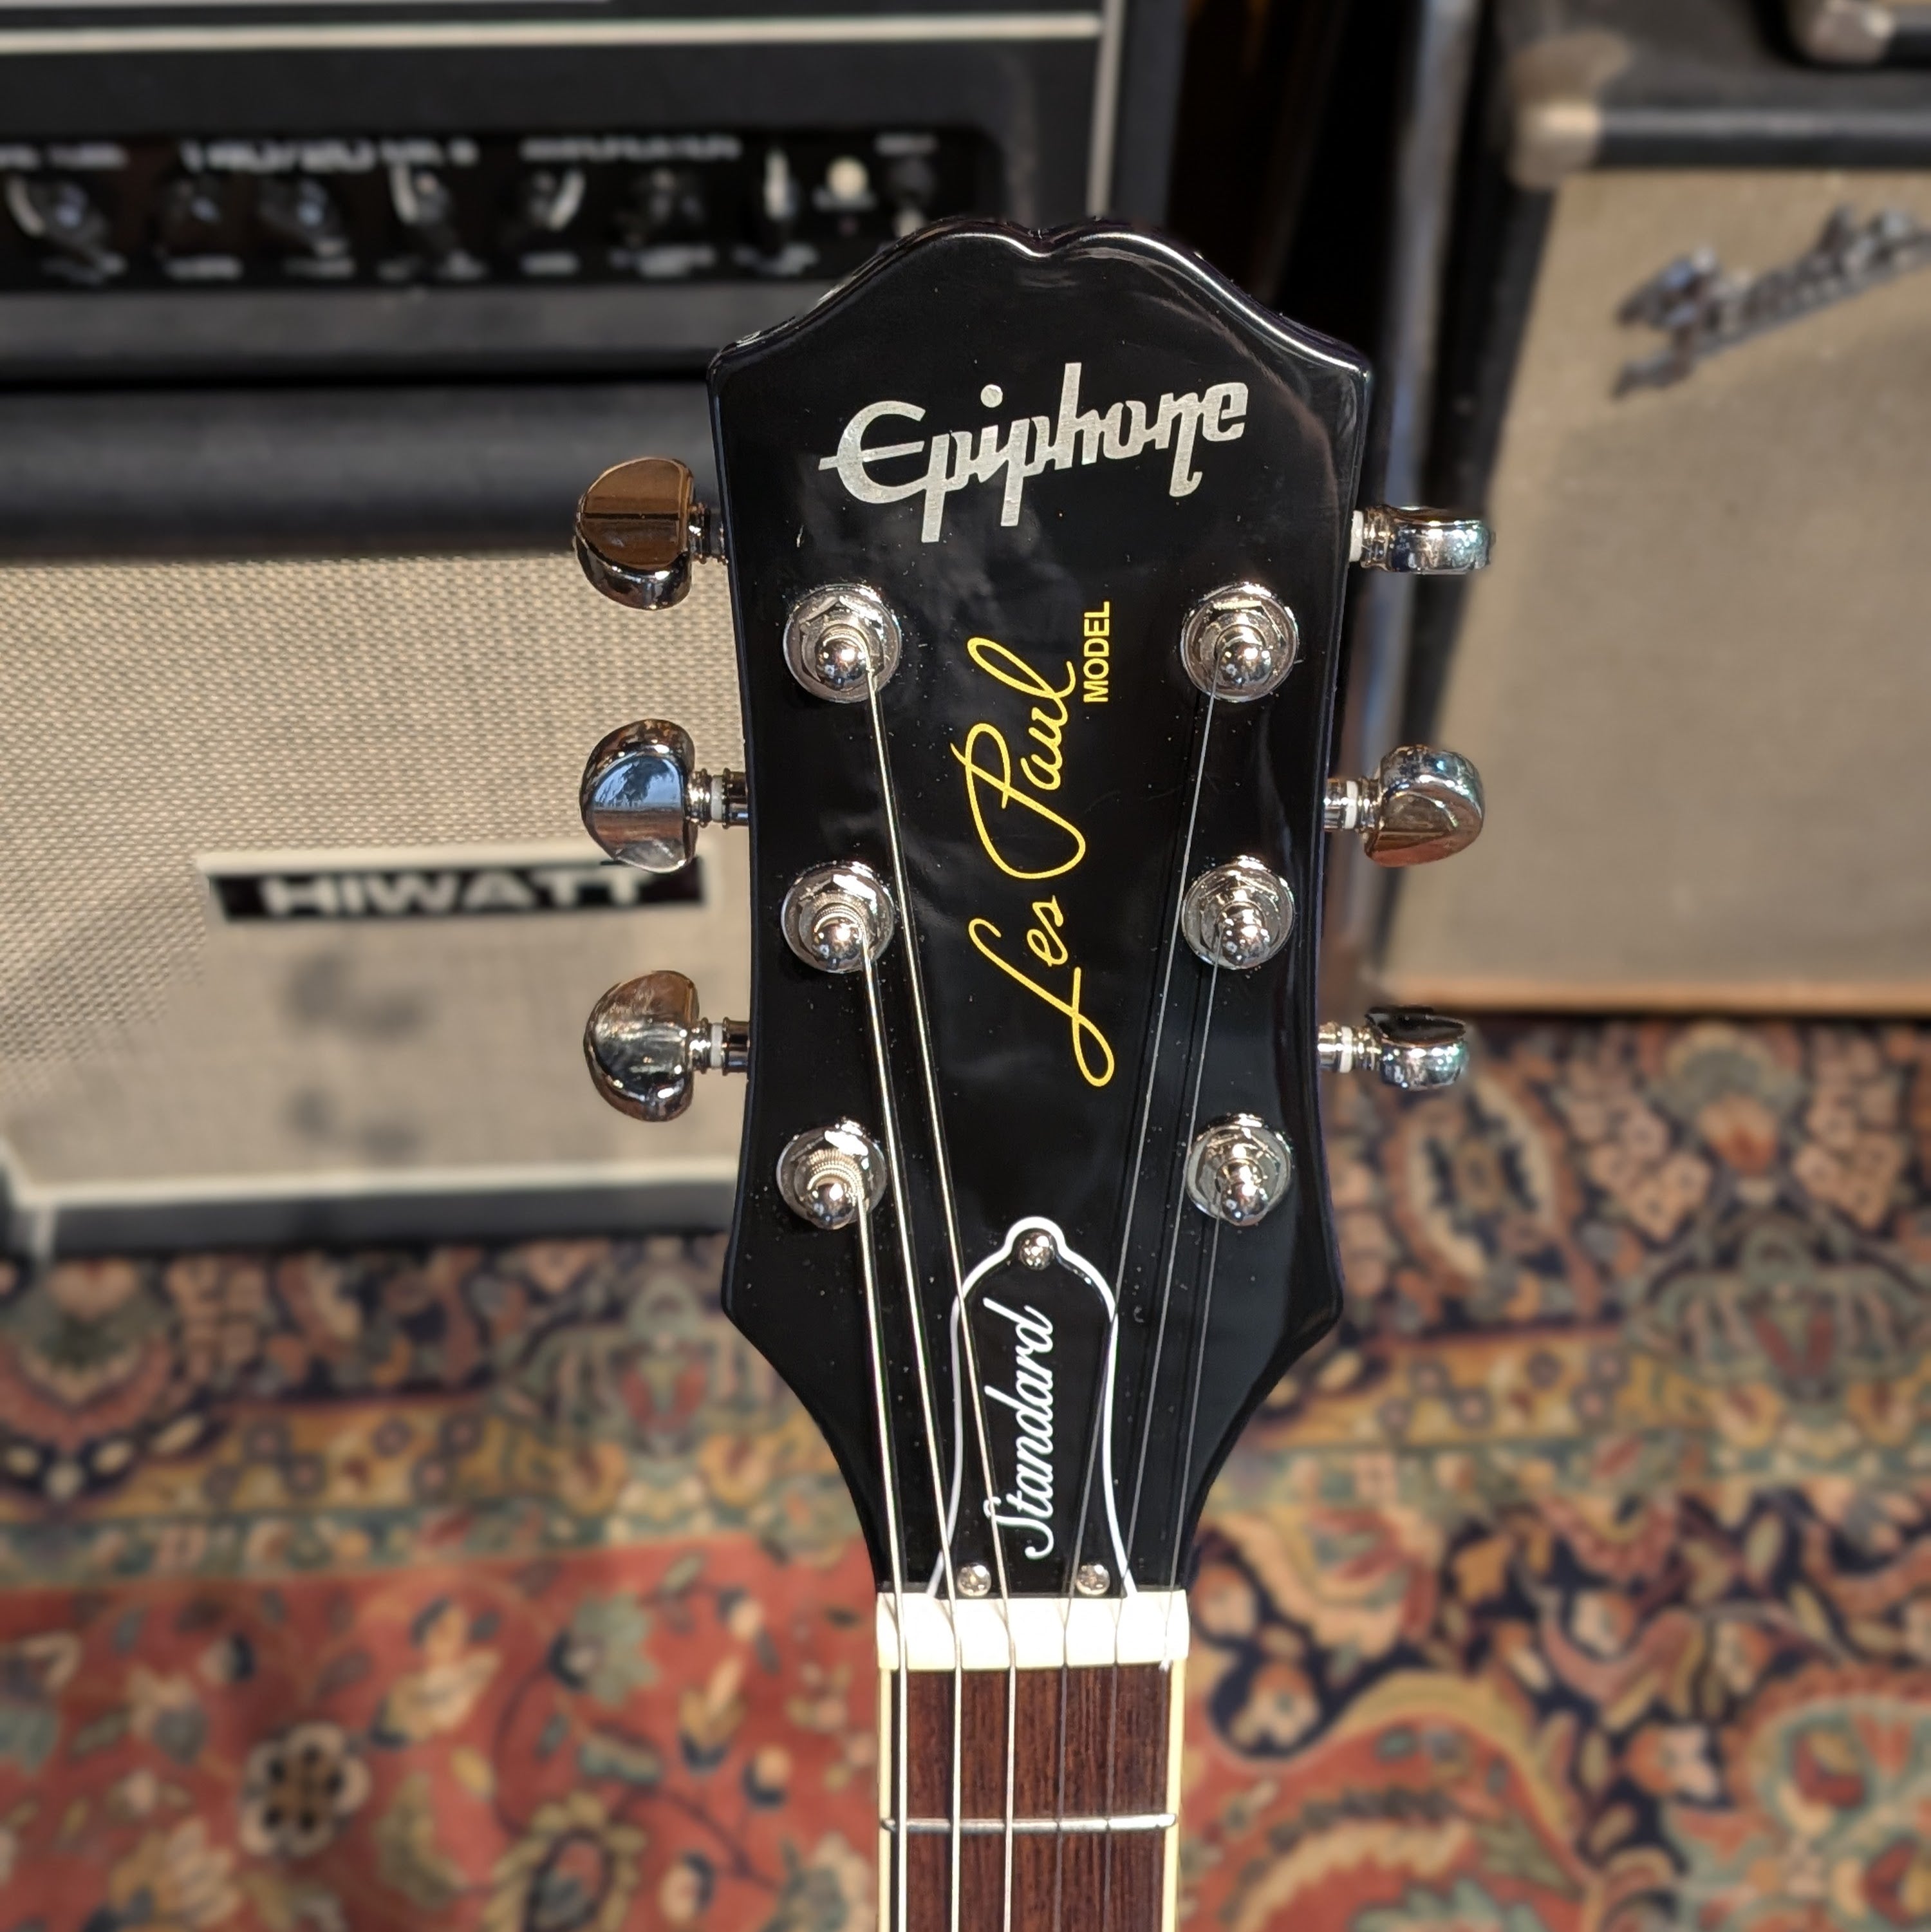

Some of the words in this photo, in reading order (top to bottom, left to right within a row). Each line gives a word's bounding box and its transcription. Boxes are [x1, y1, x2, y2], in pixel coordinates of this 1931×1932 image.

[818, 362, 1249, 543] Epiphone
[1083, 601, 1110, 703] MODEL
[950, 637, 1087, 879] Paul
[261, 867, 651, 914] HIWATT
[968, 895, 1115, 1087] Les
[982, 1296, 1054, 1560] Standard
